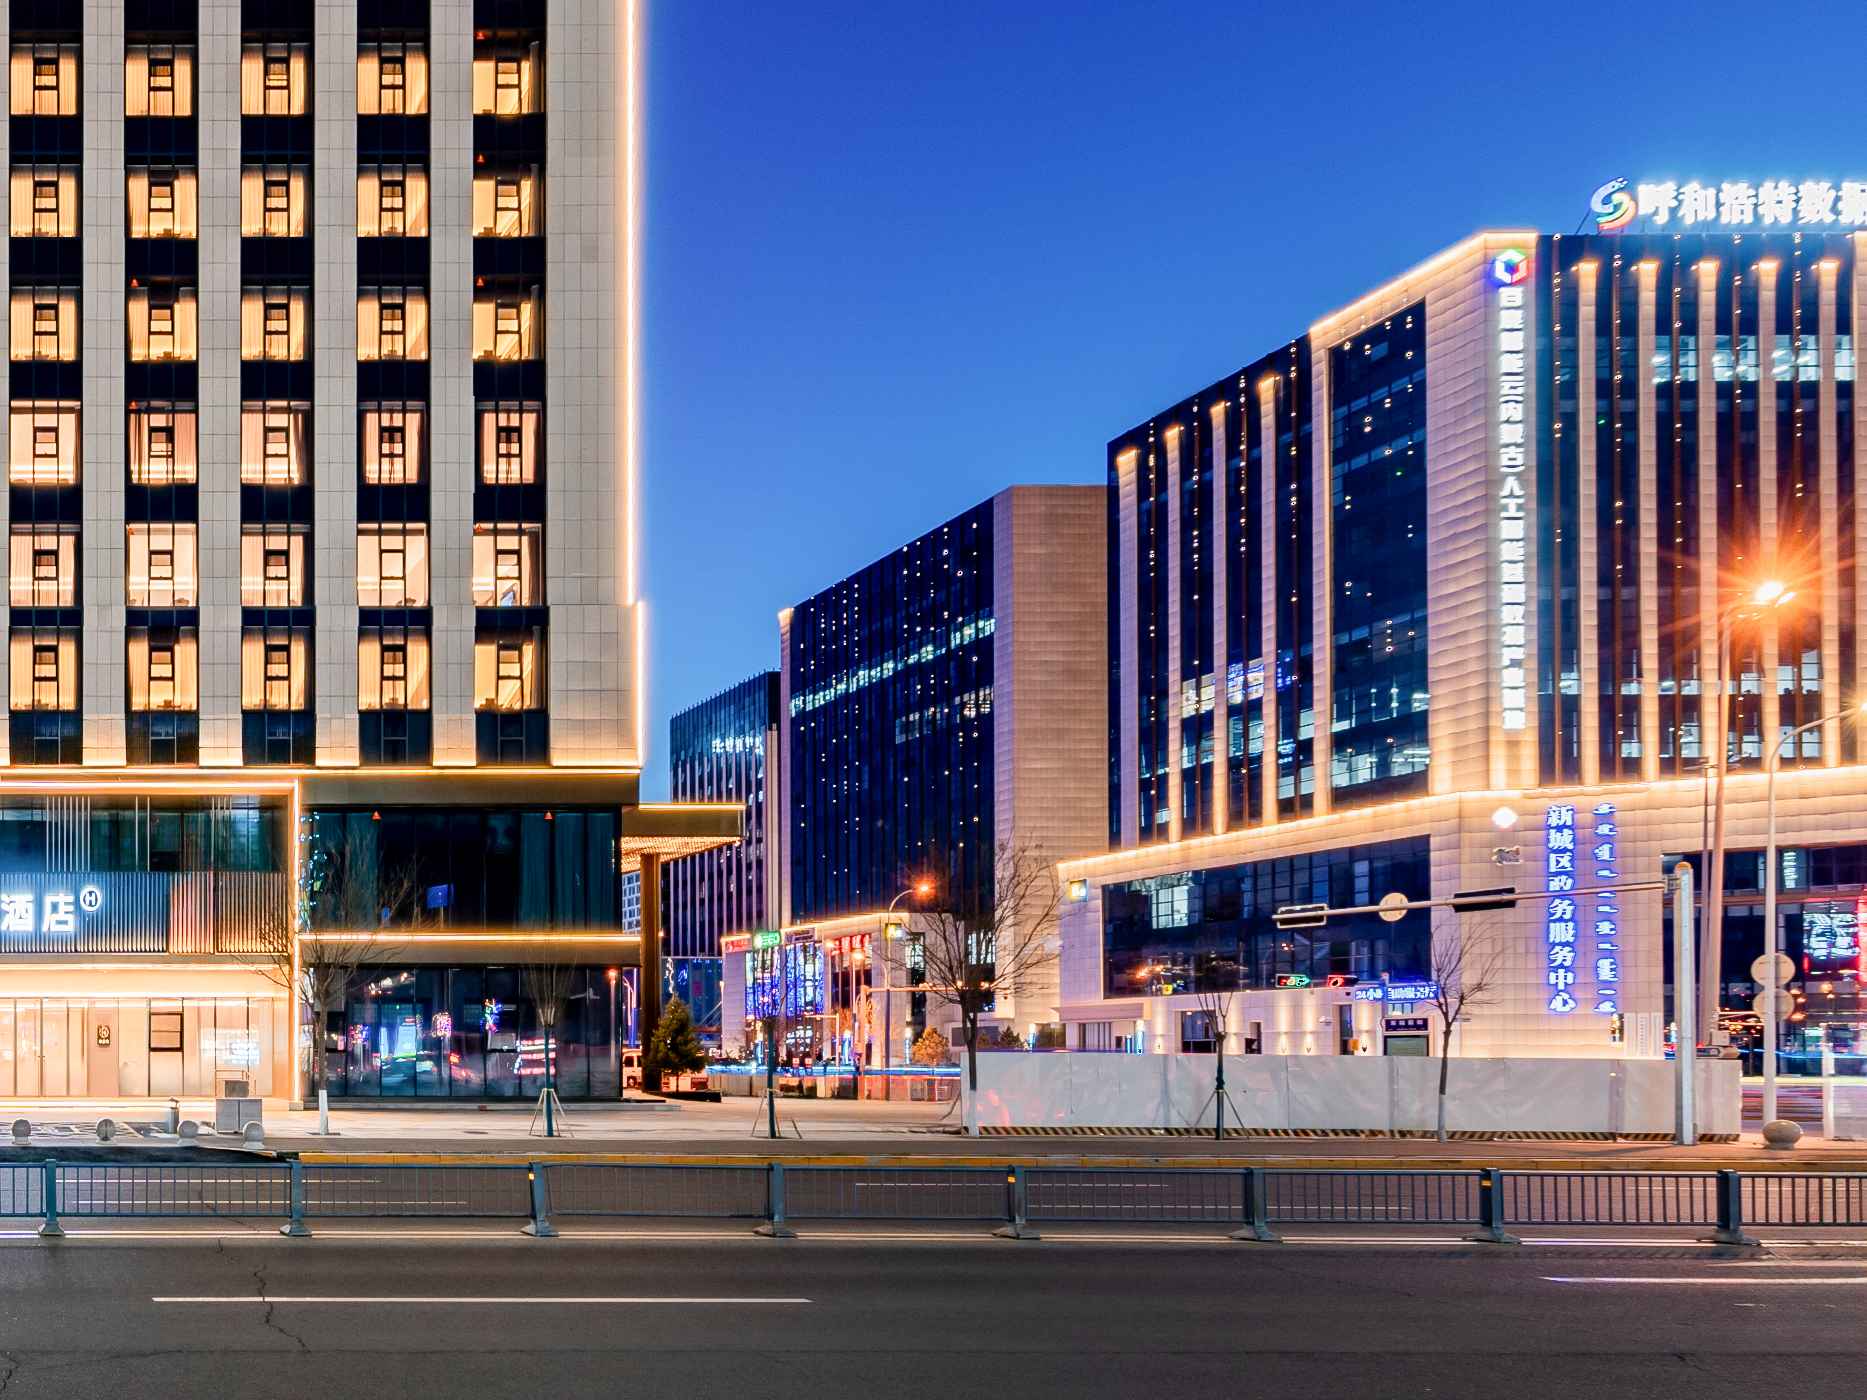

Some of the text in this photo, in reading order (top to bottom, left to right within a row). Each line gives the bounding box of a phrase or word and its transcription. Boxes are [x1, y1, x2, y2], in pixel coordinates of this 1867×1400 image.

[1546, 804, 1576, 1013] 新城区政务服务中心
